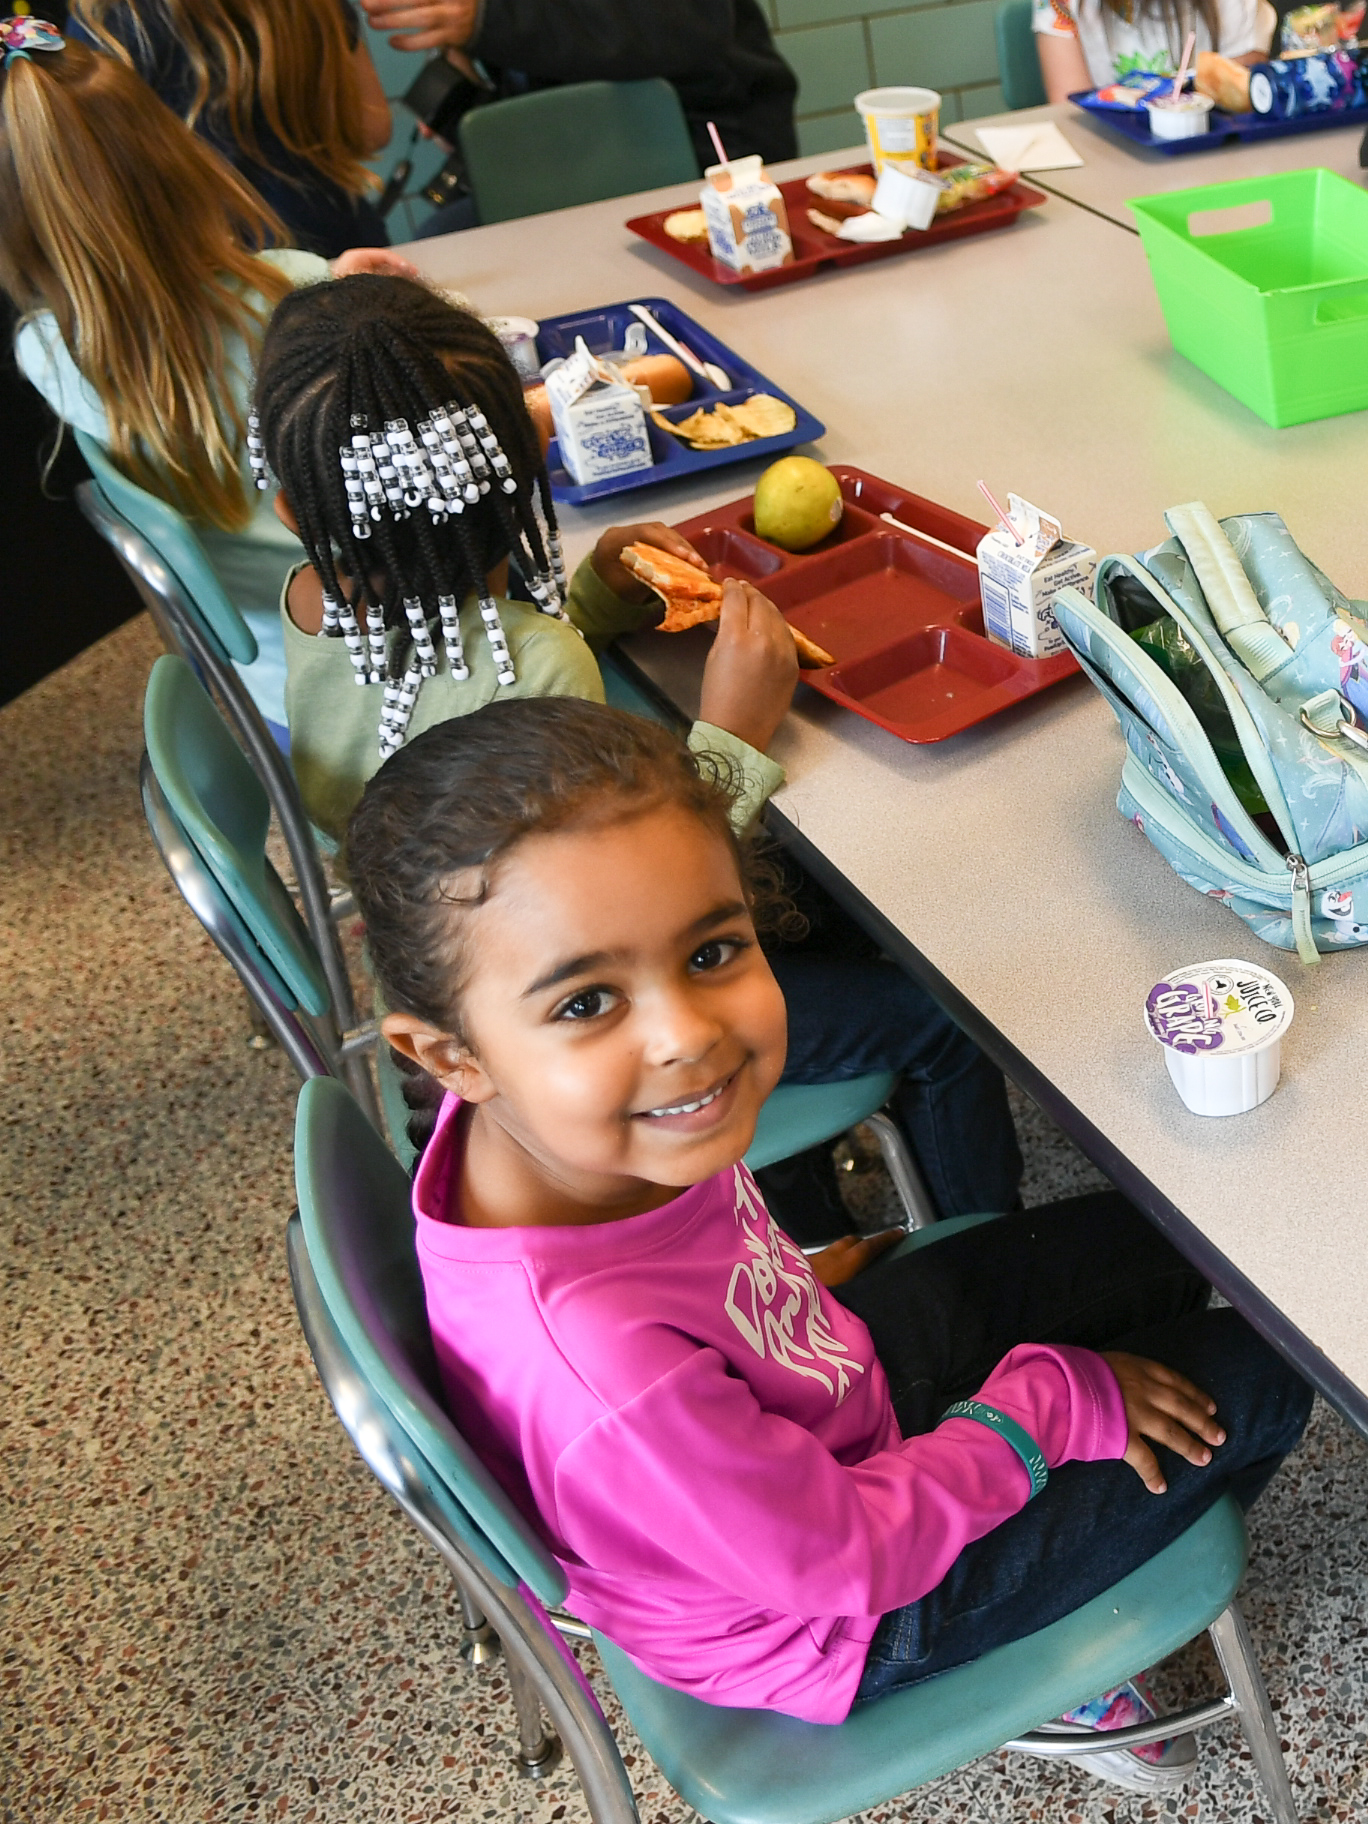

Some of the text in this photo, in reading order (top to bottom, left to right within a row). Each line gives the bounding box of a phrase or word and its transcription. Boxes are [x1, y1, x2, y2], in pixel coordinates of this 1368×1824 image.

[1237, 980, 1268, 1012] JUICE
[1254, 1010, 1277, 1025] CO.
[1262, 983, 1274, 996] NEW
[1156, 990, 1213, 1046] GRAPE
